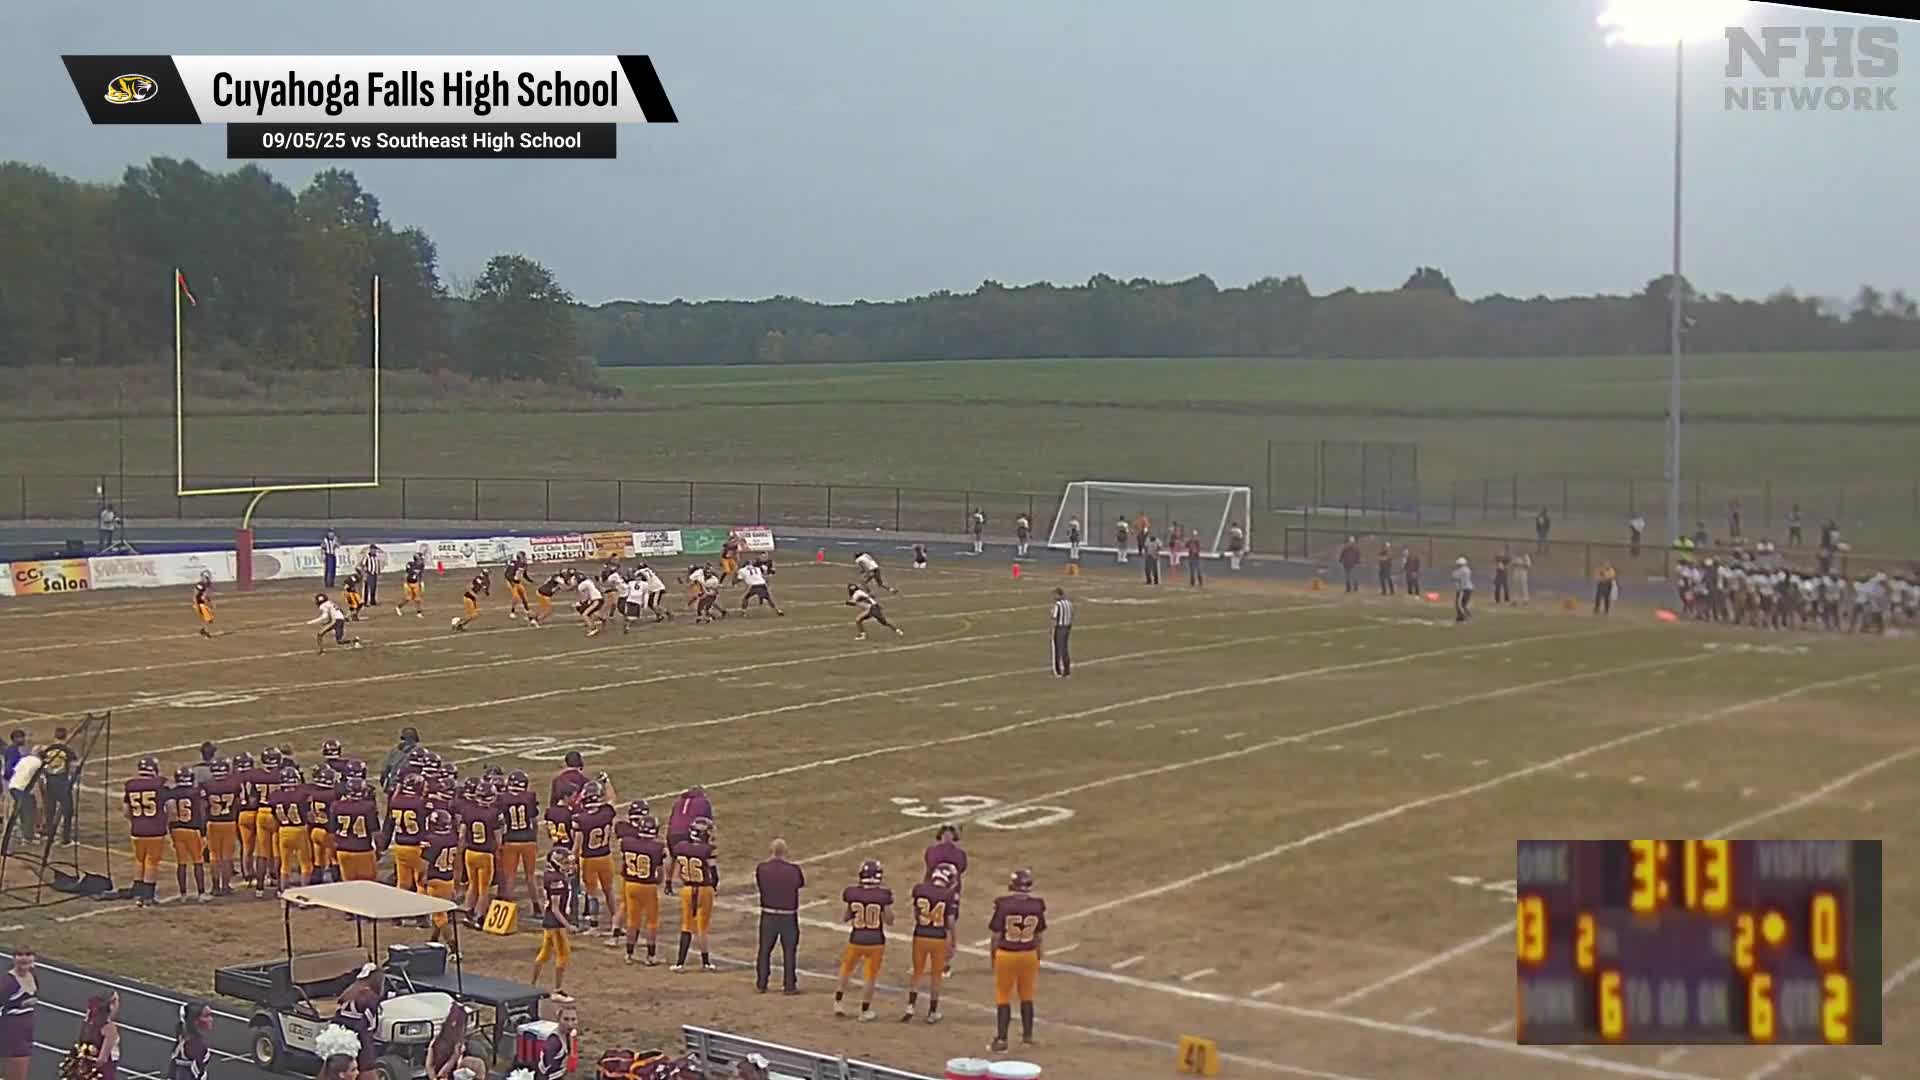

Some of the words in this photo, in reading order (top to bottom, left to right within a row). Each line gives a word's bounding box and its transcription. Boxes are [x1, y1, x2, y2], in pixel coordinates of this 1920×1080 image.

[43, 575, 89, 592] Salon
[128, 790, 157, 817] 55
[508, 804, 528, 830] 11
[891, 795, 1076, 830] 30
[337, 815, 367, 838] 74
[391, 808, 419, 835] 76
[471, 821, 486, 844] 9
[1631, 840, 1730, 911] 3:13
[487, 904, 509, 928] 30
[850, 901, 882, 929] 30
[916, 897, 946, 927] 34
[1577, 914, 1595, 969] 2
[1736, 914, 1754, 968] 2
[1812, 895, 1837, 961] 0
[1600, 970, 1625, 1040] 6
[1749, 972, 1773, 1041] 6
[1823, 973, 1849, 1041] 2
